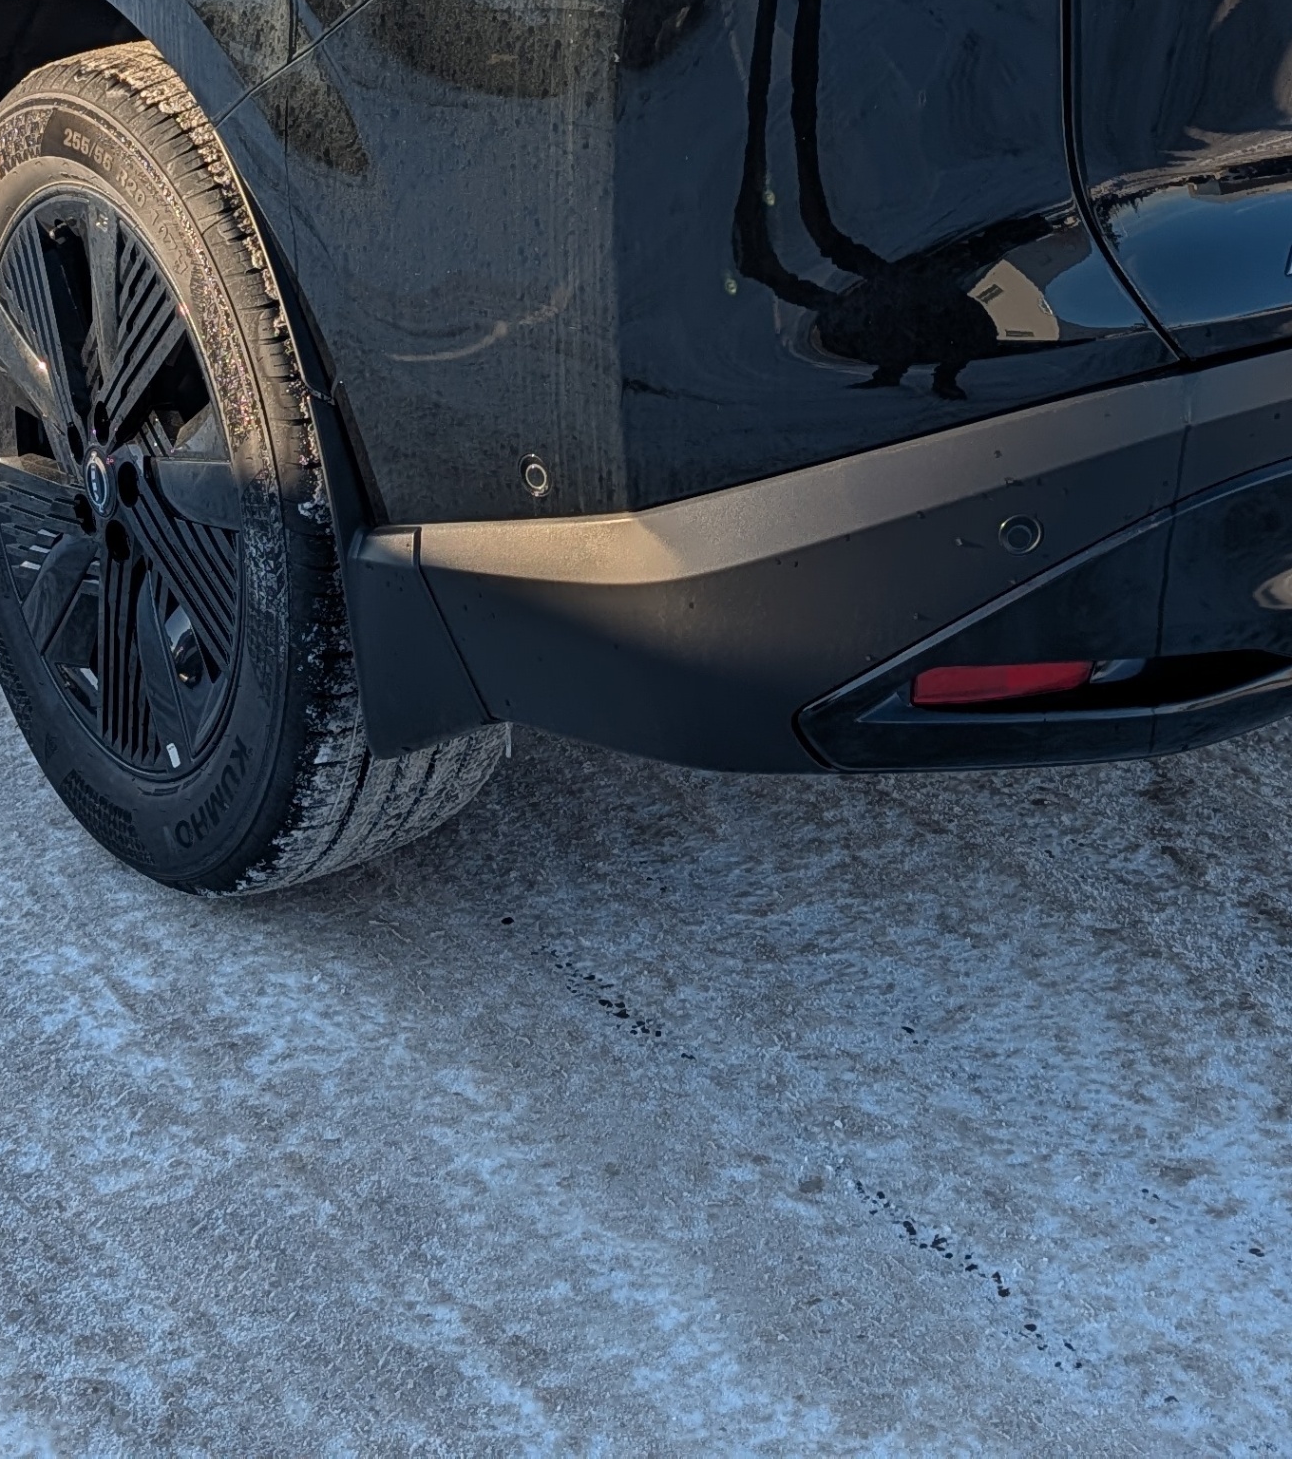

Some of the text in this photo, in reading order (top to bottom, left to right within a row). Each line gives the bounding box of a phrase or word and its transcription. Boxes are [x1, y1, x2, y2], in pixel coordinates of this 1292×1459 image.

[62, 127, 114, 173] 255/55
[115, 167, 147, 209] R20
[174, 734, 249, 849] KUMHO
